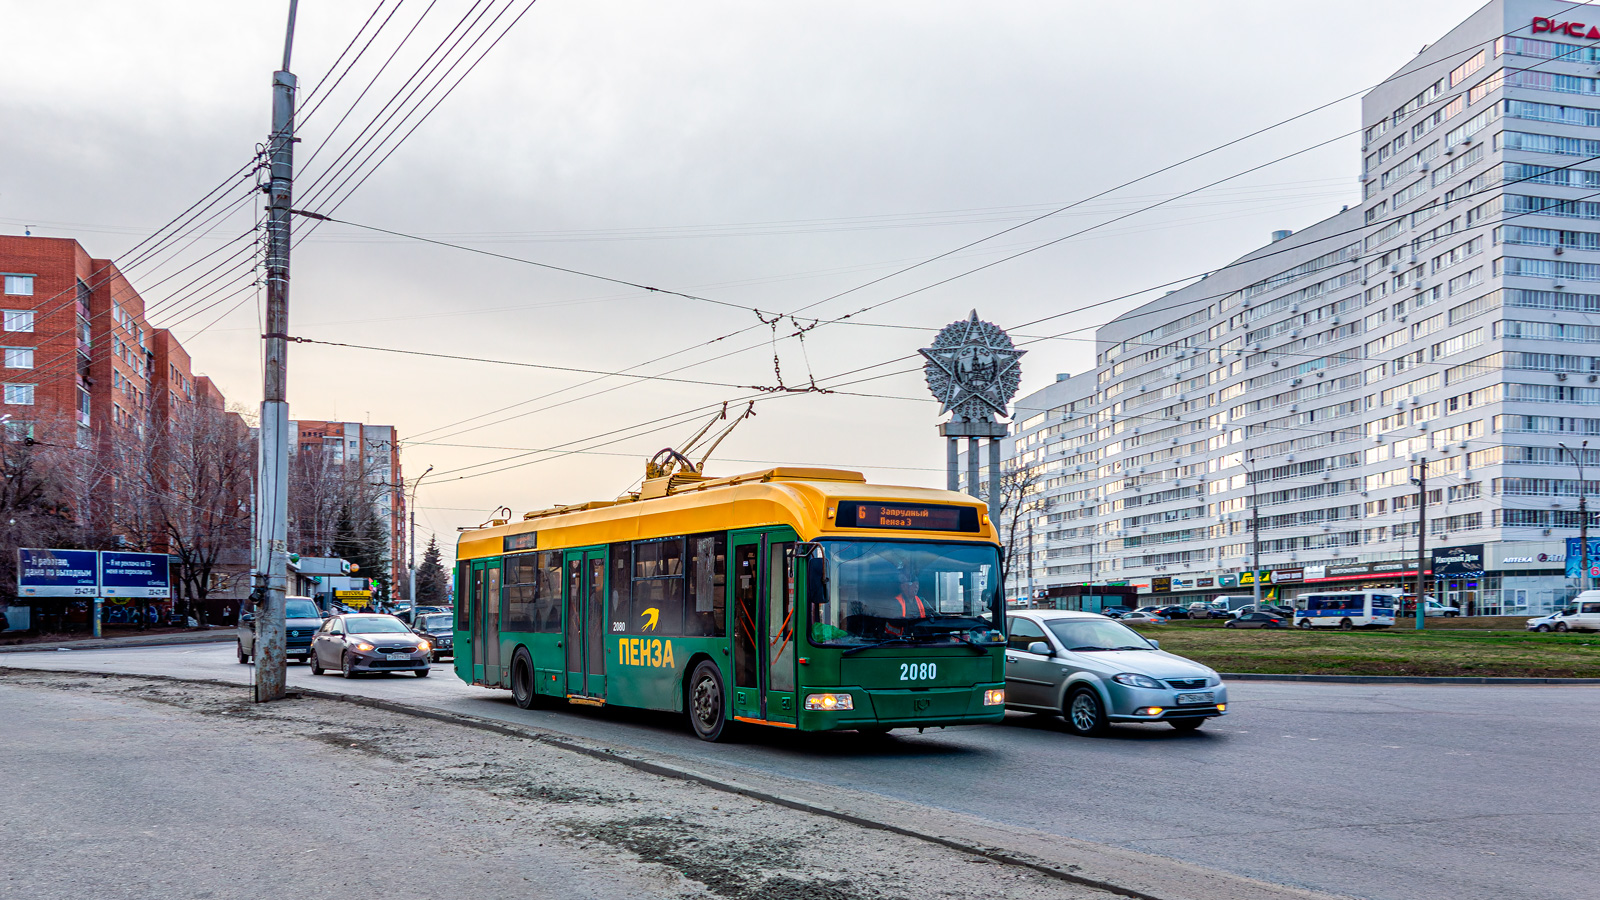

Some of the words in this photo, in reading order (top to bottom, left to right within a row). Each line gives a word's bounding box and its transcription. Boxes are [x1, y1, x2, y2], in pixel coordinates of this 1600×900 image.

[858, 506, 866, 519] 6
[880, 507, 928, 517] Запрудный
[880, 517, 905, 526] Пенза
[1464, 554, 1479, 562] Дом
[25, 568, 45, 577] даже
[612, 621, 626, 632] 2080
[619, 638, 675, 668] ПЕНЗА
[900, 662, 937, 680] 2080
